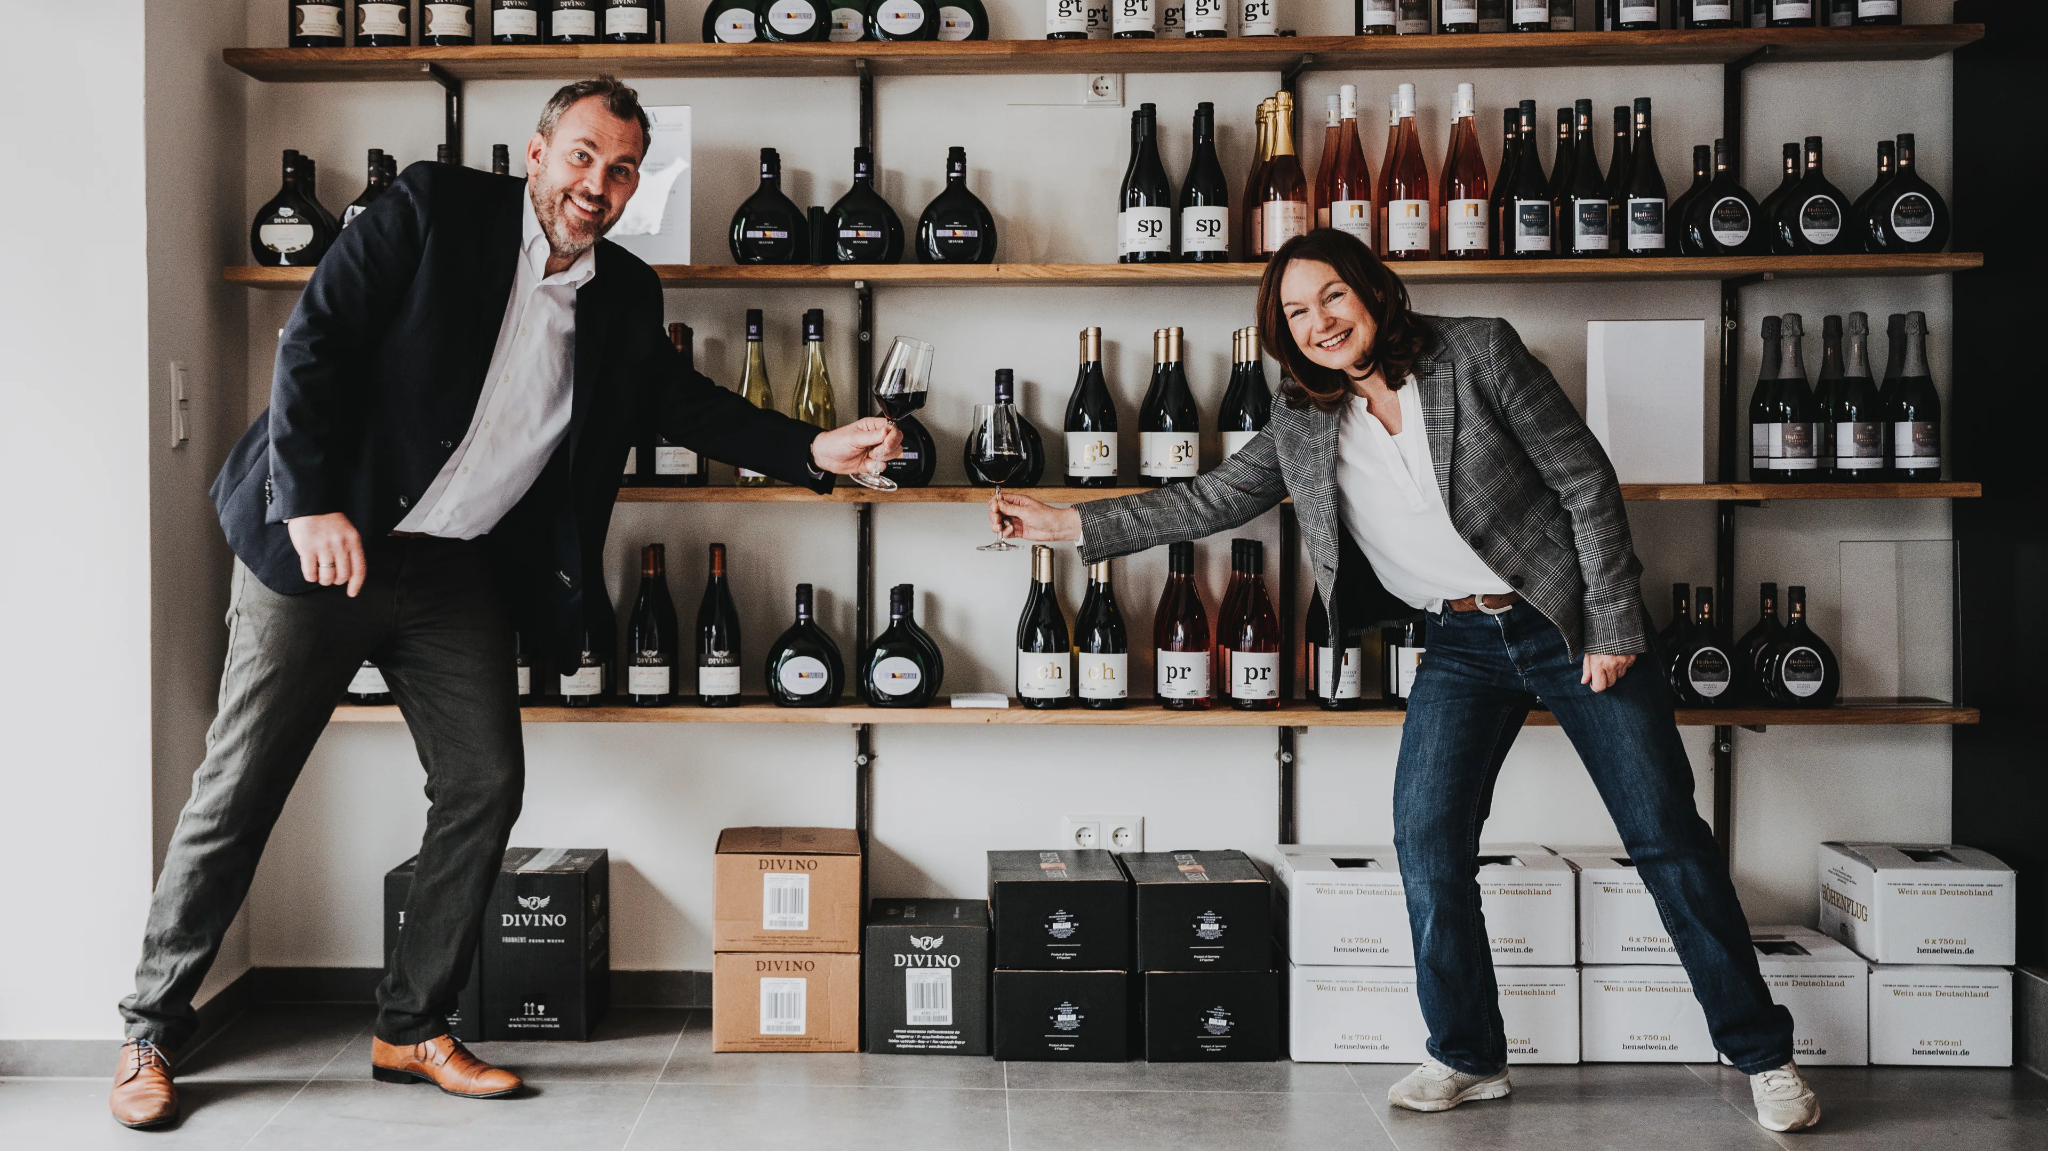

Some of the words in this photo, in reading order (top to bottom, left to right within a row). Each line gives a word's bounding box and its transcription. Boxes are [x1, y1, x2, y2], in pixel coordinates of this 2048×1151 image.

[1058, 0, 1082, 17] gt
[1088, 5, 1108, 26] gt
[1124, 0, 1148, 16] gt
[1196, 0, 1220, 16] gt
[1245, 0, 1269, 21] gt
[1138, 219, 1163, 237] sp
[1196, 219, 1221, 237] sp
[1084, 440, 1109, 462] gb
[1169, 440, 1194, 463] gb
[1037, 662, 1063, 680] ch
[1088, 663, 1115, 680] ch
[1166, 666, 1191, 684] pr
[1244, 666, 1271, 684] pr
[759, 859, 818, 871] DIVINO
[1499, 888, 1552, 896] Deutschland
[1822, 883, 1868, 922] HÖHENFLUG
[502, 914, 566, 926] DIVINO
[1333, 946, 1389, 954] henselwein.de
[1917, 947, 1974, 955] henselwein.de
[756, 960, 815, 972] DIVINO
[893, 954, 960, 968] DIVINO
[1316, 984, 1336, 992] Wein
[1357, 985, 1409, 993] Deutschland
[1334, 1043, 1390, 1051] henselwein.de
[1622, 1043, 1678, 1051] henselwein.de
[1912, 1048, 1970, 1056] henselwein.de
